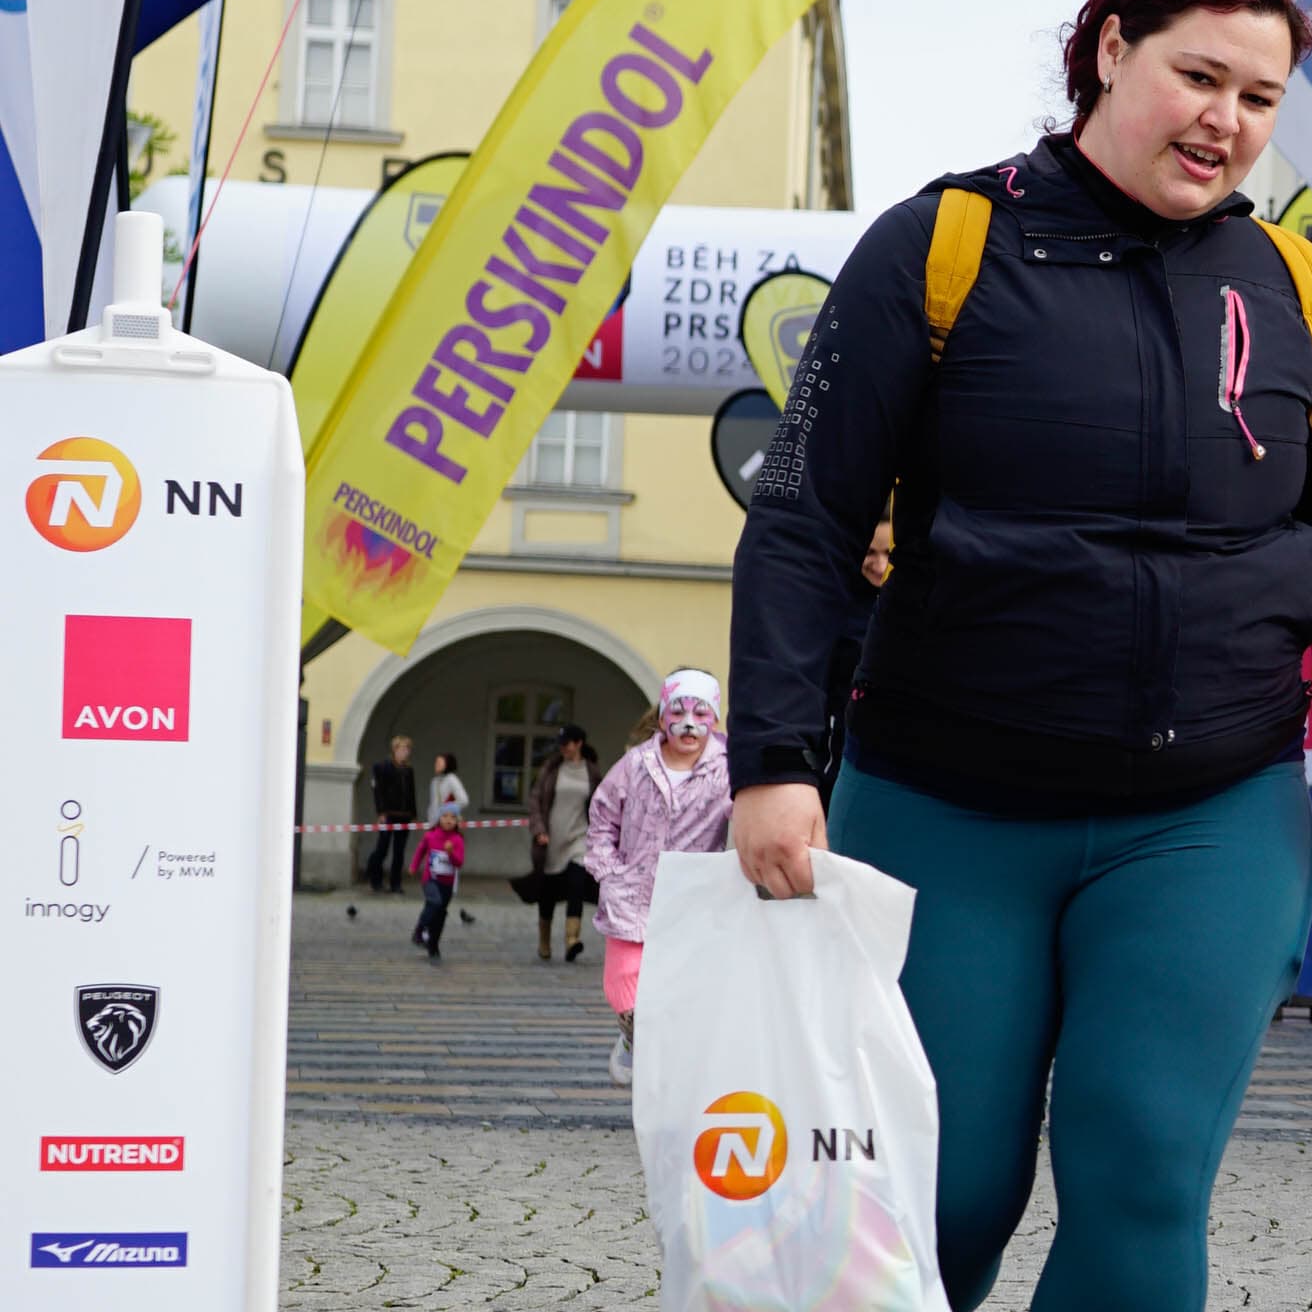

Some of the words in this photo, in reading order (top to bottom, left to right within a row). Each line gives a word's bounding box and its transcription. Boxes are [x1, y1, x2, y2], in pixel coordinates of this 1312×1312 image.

[385, 20, 714, 485] PERSKINDOL
[664, 277, 738, 305] ZDR
[664, 313, 732, 340] PRS
[165, 479, 243, 517] NN
[333, 480, 438, 560] PERSKINDOL
[74, 706, 175, 731] AVON
[158, 851, 216, 864] Powered
[157, 866, 175, 879] by
[179, 867, 215, 878] MVM
[25, 897, 110, 923] innogy
[82, 991, 153, 1002] PEUGEOT
[47, 1143, 180, 1166] NUTREND
[811, 1128, 875, 1162] NN
